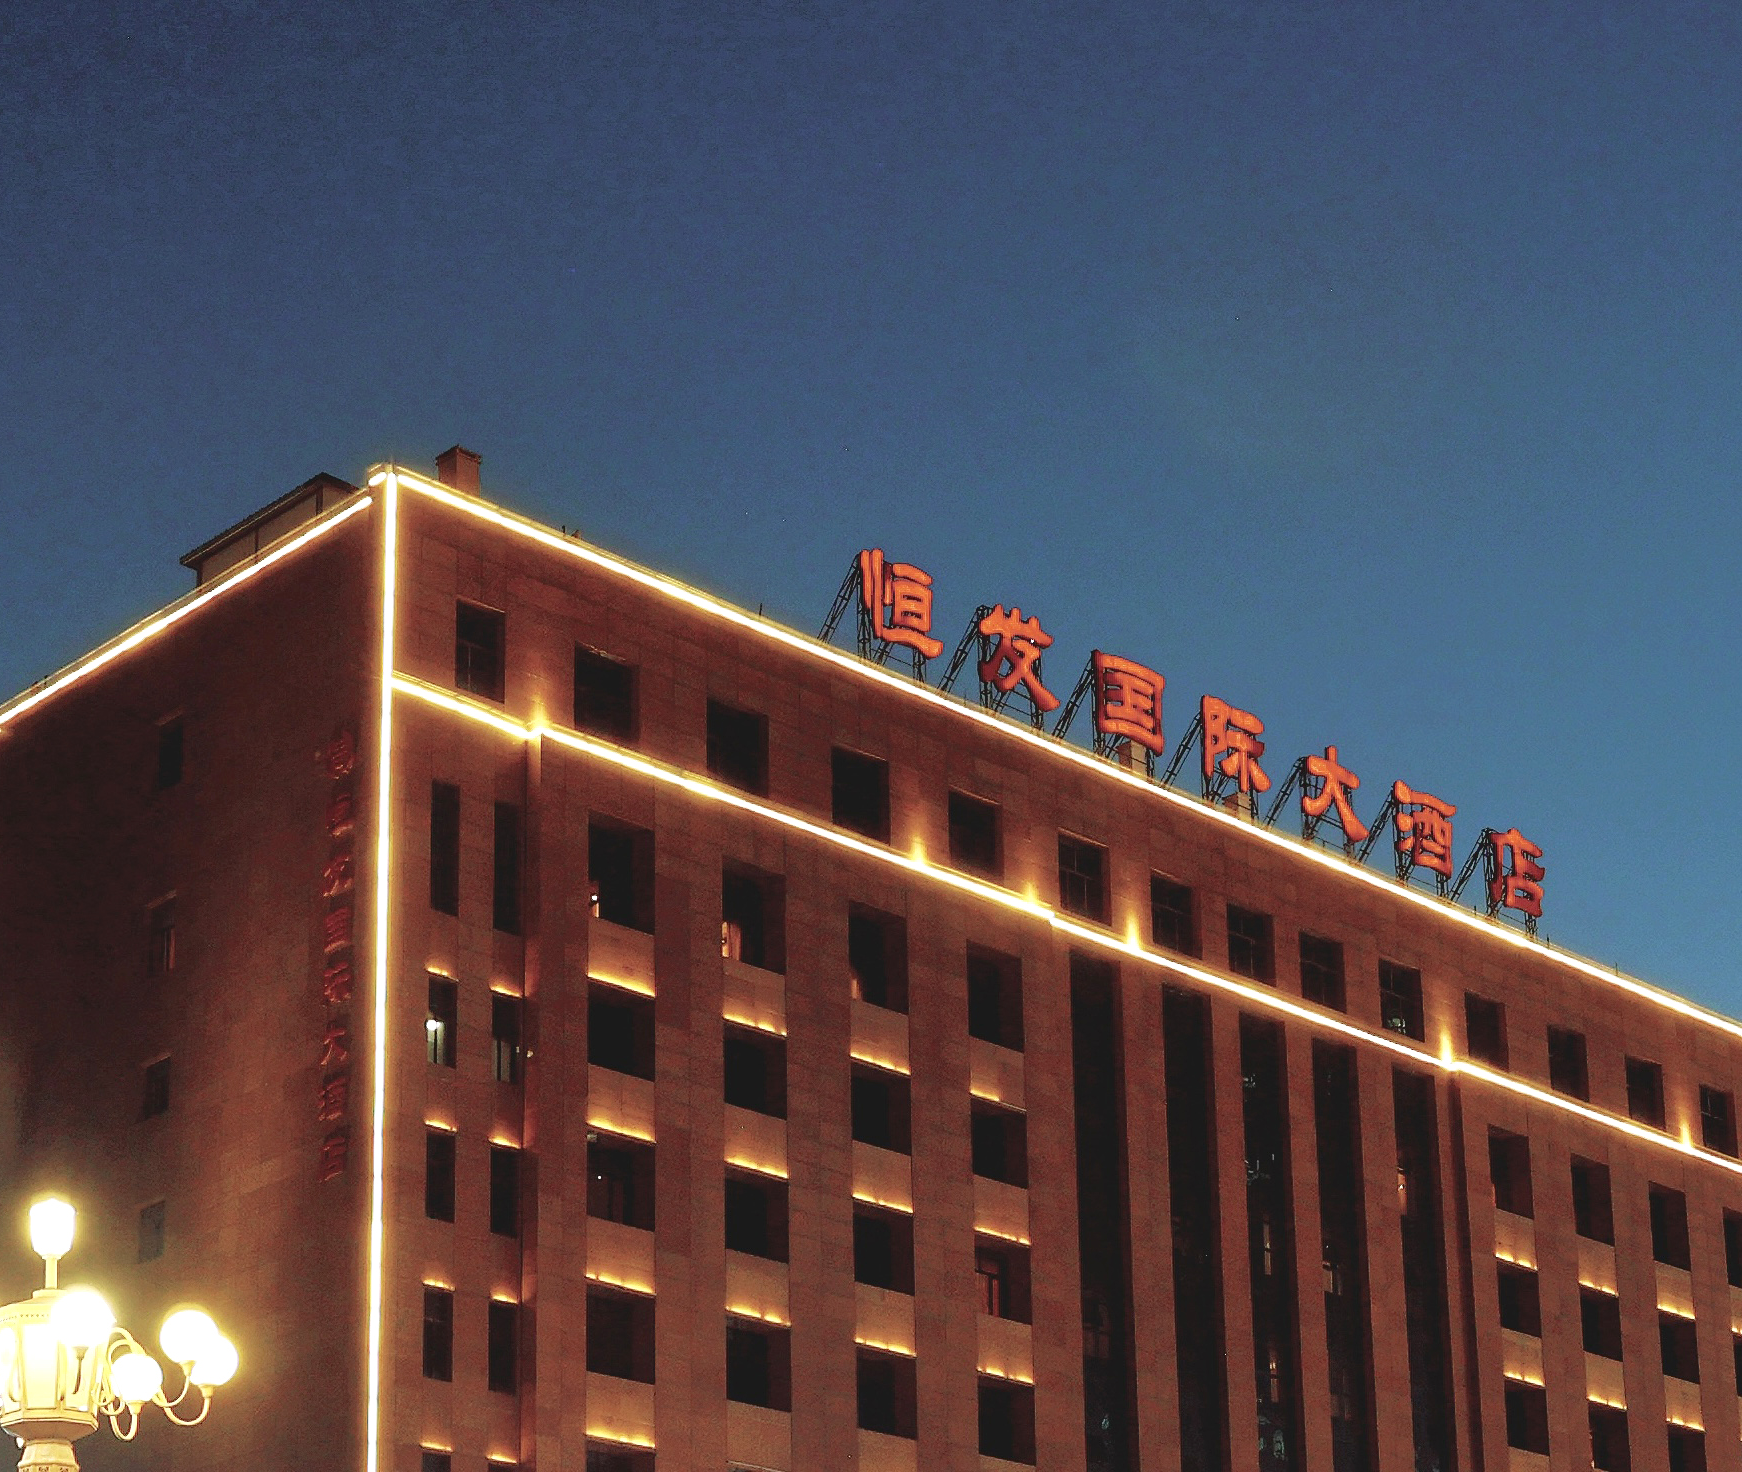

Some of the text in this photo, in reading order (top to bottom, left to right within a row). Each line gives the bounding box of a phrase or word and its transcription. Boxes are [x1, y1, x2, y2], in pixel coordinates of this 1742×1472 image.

[860, 548, 1545, 918] 恒发国际大酒店
